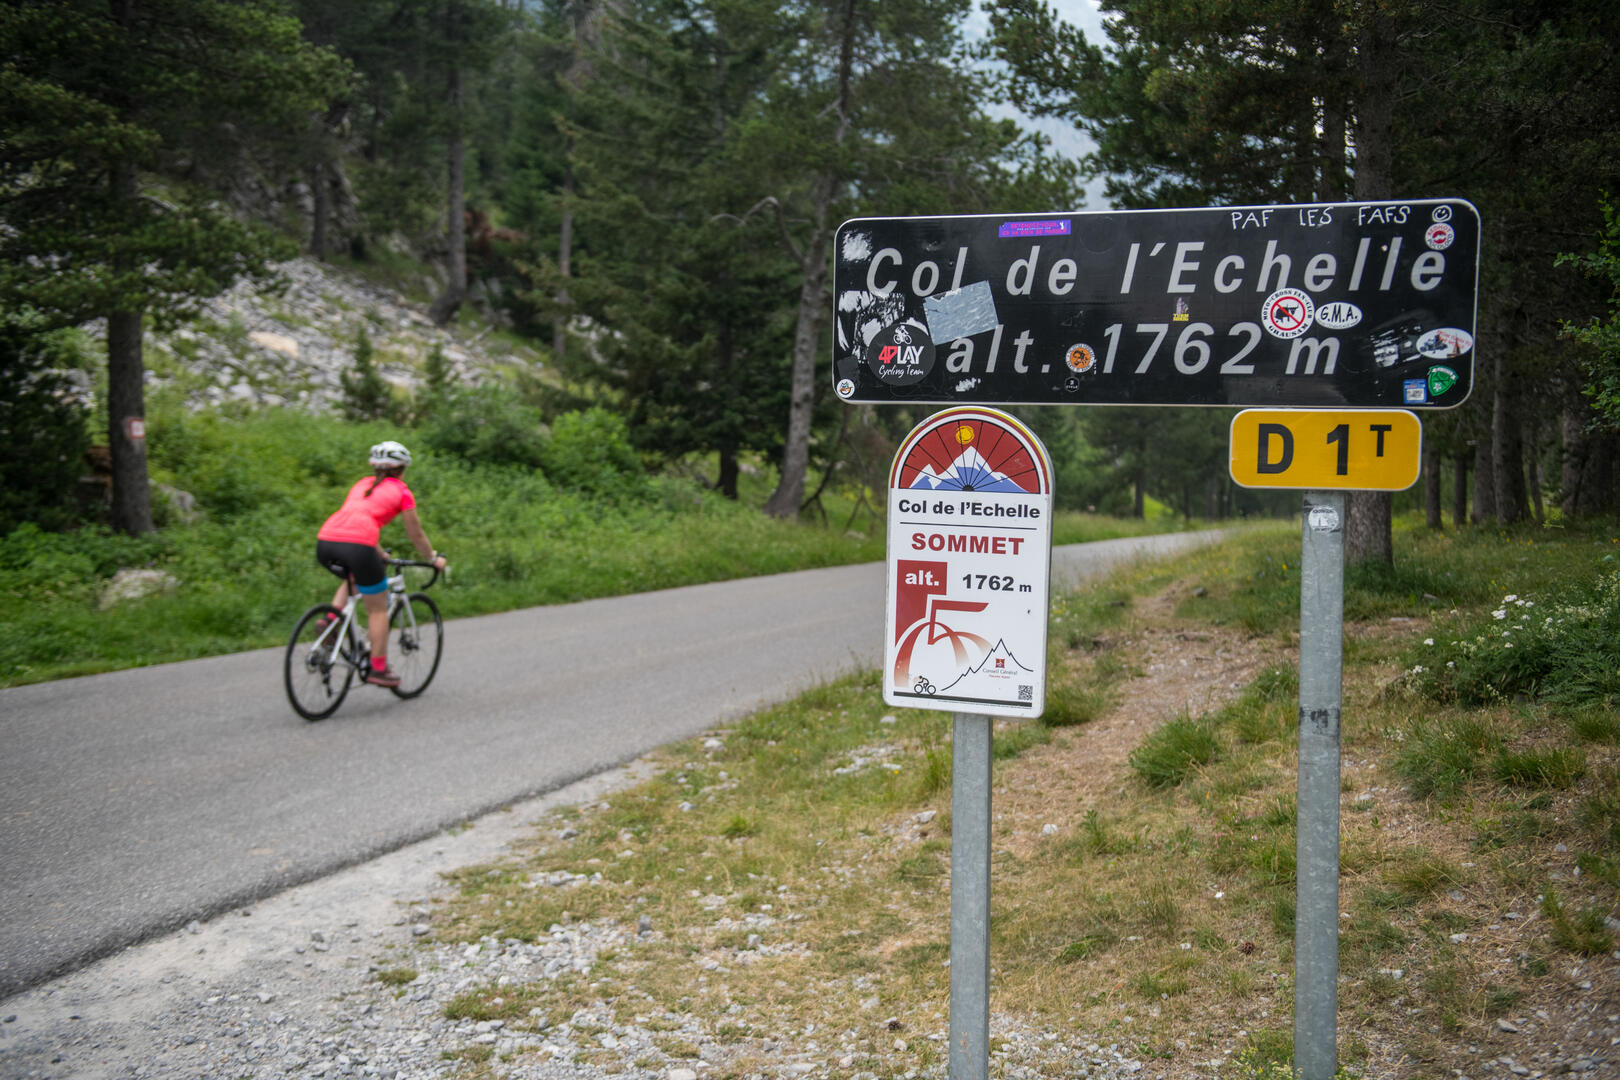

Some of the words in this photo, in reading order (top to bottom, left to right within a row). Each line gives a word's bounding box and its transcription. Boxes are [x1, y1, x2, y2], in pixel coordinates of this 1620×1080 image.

[1231, 208, 1274, 230] PAF
[1299, 206, 1334, 227] LES
[1357, 204, 1412, 227] FAFS
[866, 246, 968, 298] Col
[1006, 245, 1078, 296] de
[1120, 236, 1446, 295] l'Echelle
[1320, 303, 1358, 323] G.M.A.
[878, 345, 924, 365] 4PLAY
[945, 324, 1051, 375] alt.
[1103, 321, 1263, 375] 1762
[1285, 336, 1341, 375] m
[878, 364, 905, 379] Cycling
[1256, 422, 1295, 475] D
[898, 499, 928, 514] Col
[933, 500, 955, 515] de
[960, 502, 1041, 519] l'Echelle
[911, 532, 1025, 556] SOMMET
[904, 570, 940, 587] alt.
[962, 573, 1015, 593] 1762
[1019, 583, 1032, 593] m
